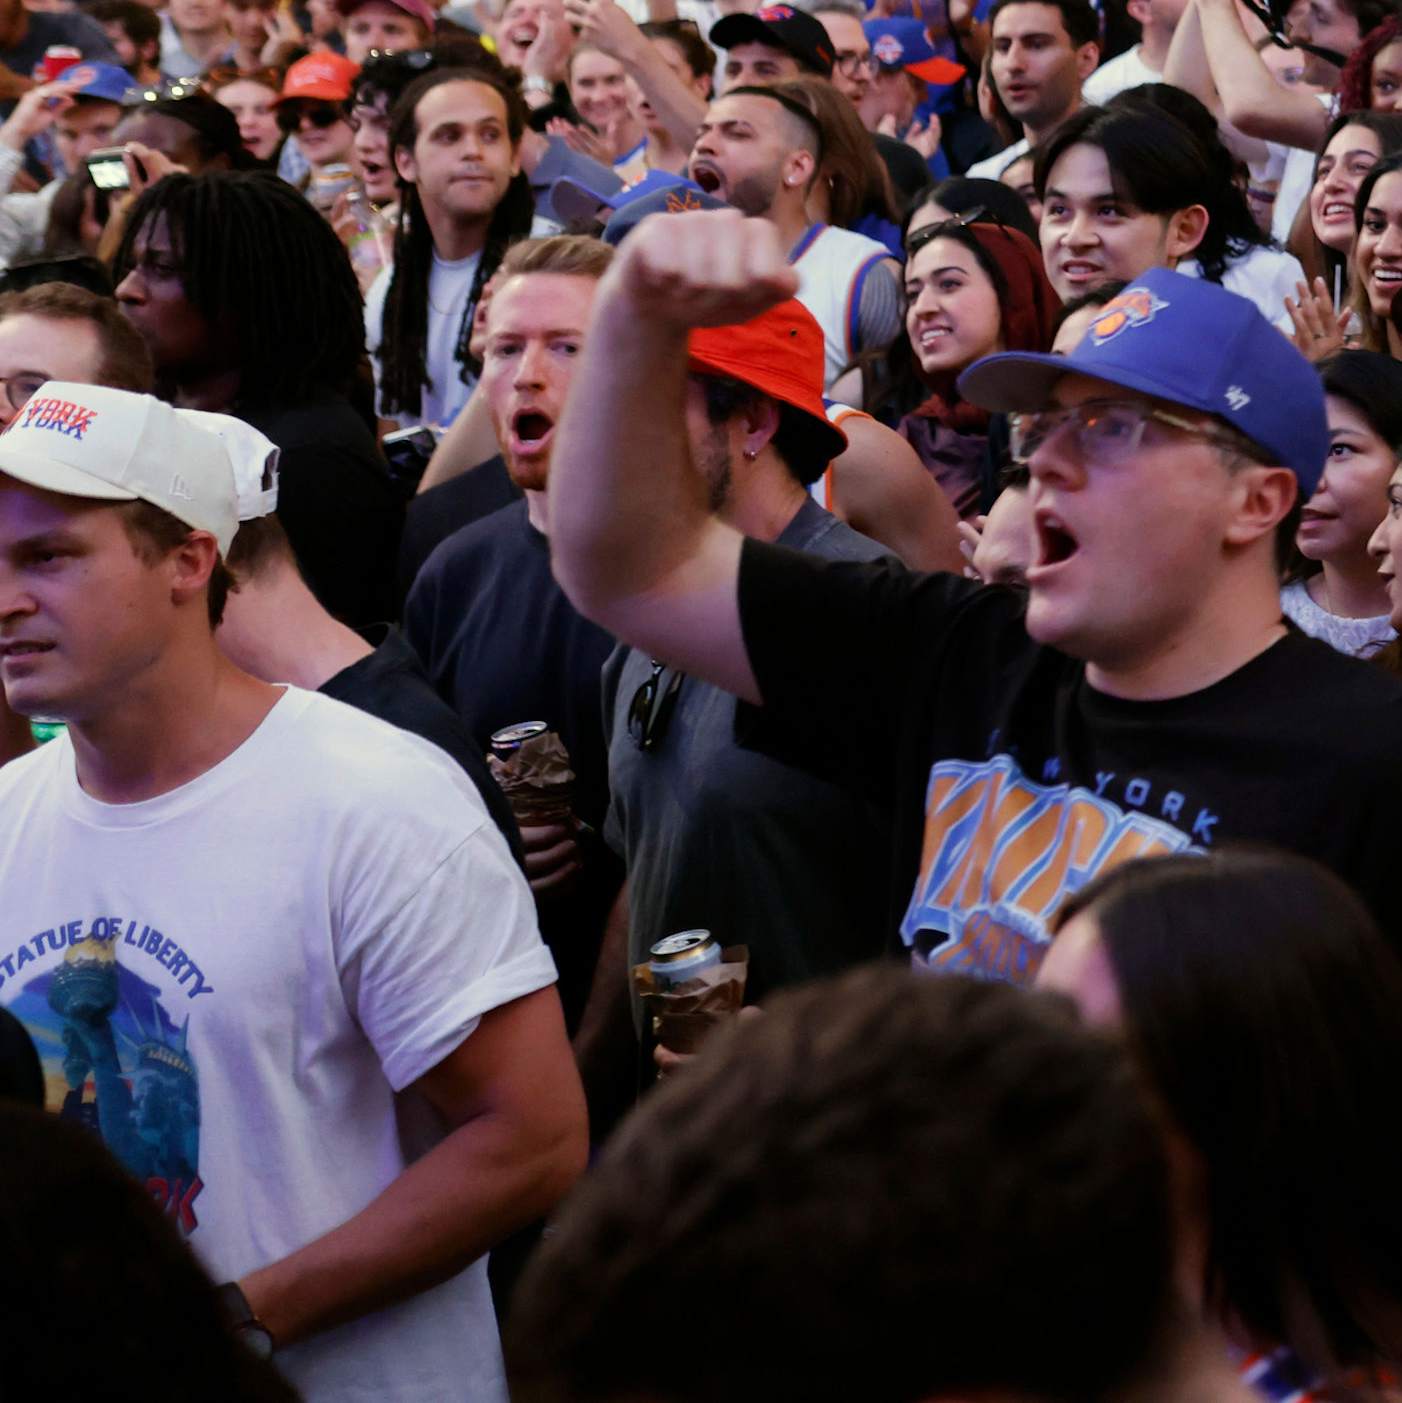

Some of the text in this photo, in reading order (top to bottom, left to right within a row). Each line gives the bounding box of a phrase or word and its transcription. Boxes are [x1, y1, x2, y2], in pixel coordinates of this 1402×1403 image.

[1095, 770, 1219, 843] YORK
[91, 916, 123, 941] OF
[124, 920, 214, 999] LIBERTY
